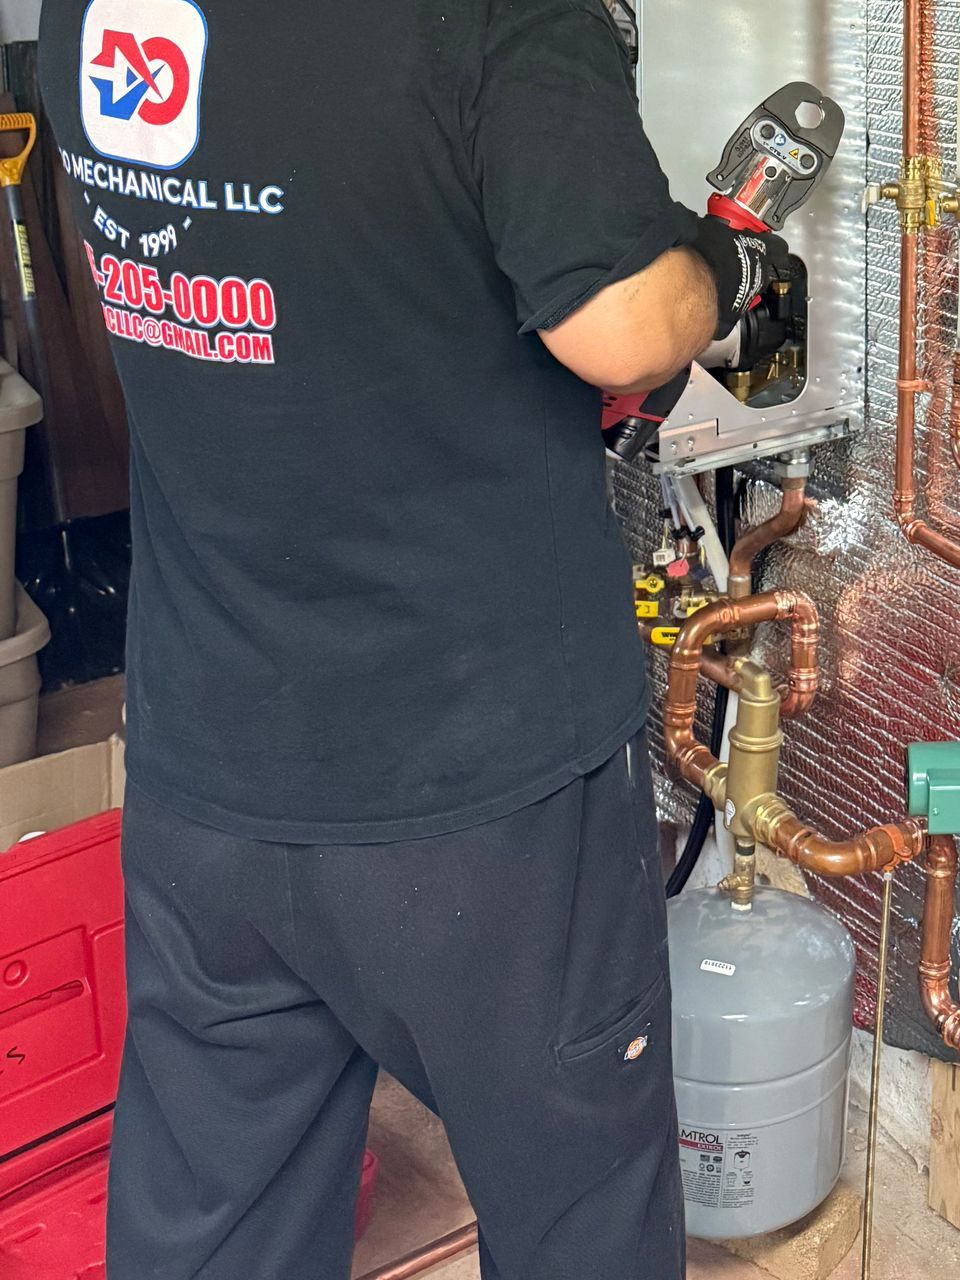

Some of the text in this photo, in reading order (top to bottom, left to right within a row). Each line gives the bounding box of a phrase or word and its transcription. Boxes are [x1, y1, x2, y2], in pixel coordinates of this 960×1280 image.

[72, 152, 218, 210] MECHANICAL
[224, 182, 285, 215] LLC
[93, 205, 178, 257] EST 1999
[84, 240, 276, 330] -205-0000
[680, 1129, 723, 1145] MTROL
